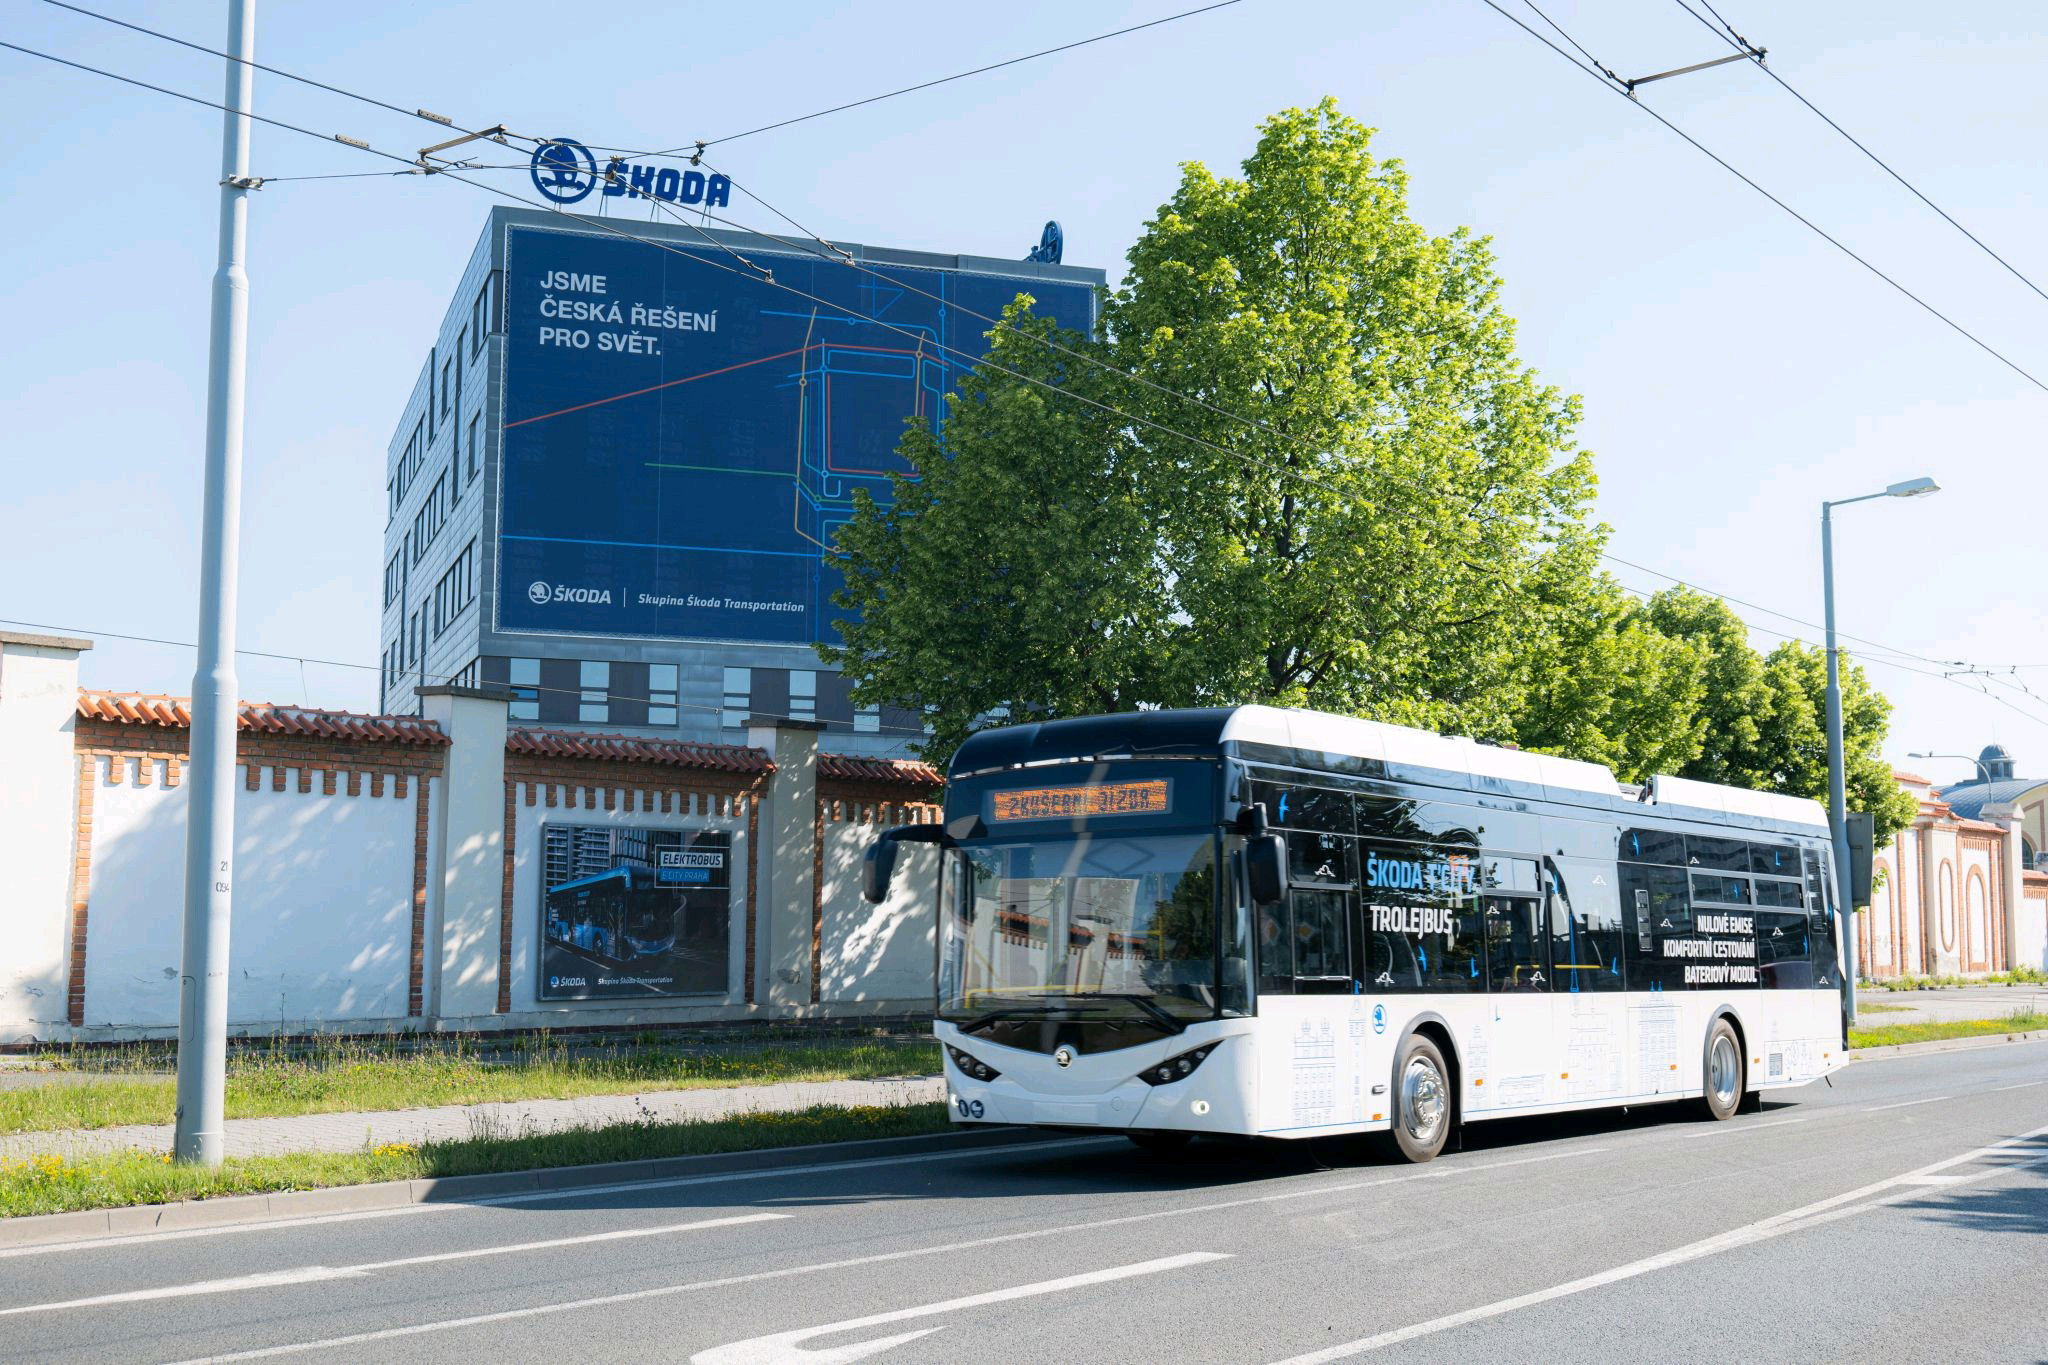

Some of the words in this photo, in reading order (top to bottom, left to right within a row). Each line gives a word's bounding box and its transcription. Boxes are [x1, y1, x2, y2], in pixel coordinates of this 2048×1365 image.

[603, 160, 731, 207] ŠKODA
[540, 270, 607, 294] JSME
[540, 293, 624, 324] ČESKÁ
[631, 302, 718, 332] ŘEŠENÍ
[539, 326, 591, 349] PRO
[597, 330, 661, 355] SVĚT.
[554, 584, 612, 604] ŠKODA
[638, 593, 684, 606] Skupina
[687, 593, 721, 608] Škoda
[724, 598, 805, 612] Transportation
[220, 860, 228, 871] 21
[663, 853, 721, 866] ELEKTROBUS
[1367, 851, 1424, 889] ŠKODA
[684, 871, 709, 882] PRAHA
[1369, 905, 1452, 939] TROLEJBUS
[1697, 912, 1729, 933] NULOVÉ
[1730, 916, 1753, 933] EMISE
[1664, 936, 1712, 957] KOMFORTNÍ
[1713, 937, 1755, 958] CESTOVÁNÍ
[560, 976, 586, 987] ŠKODA
[1684, 961, 1729, 983] BATERIOVÝ
[1730, 966, 1757, 983] MODUL
